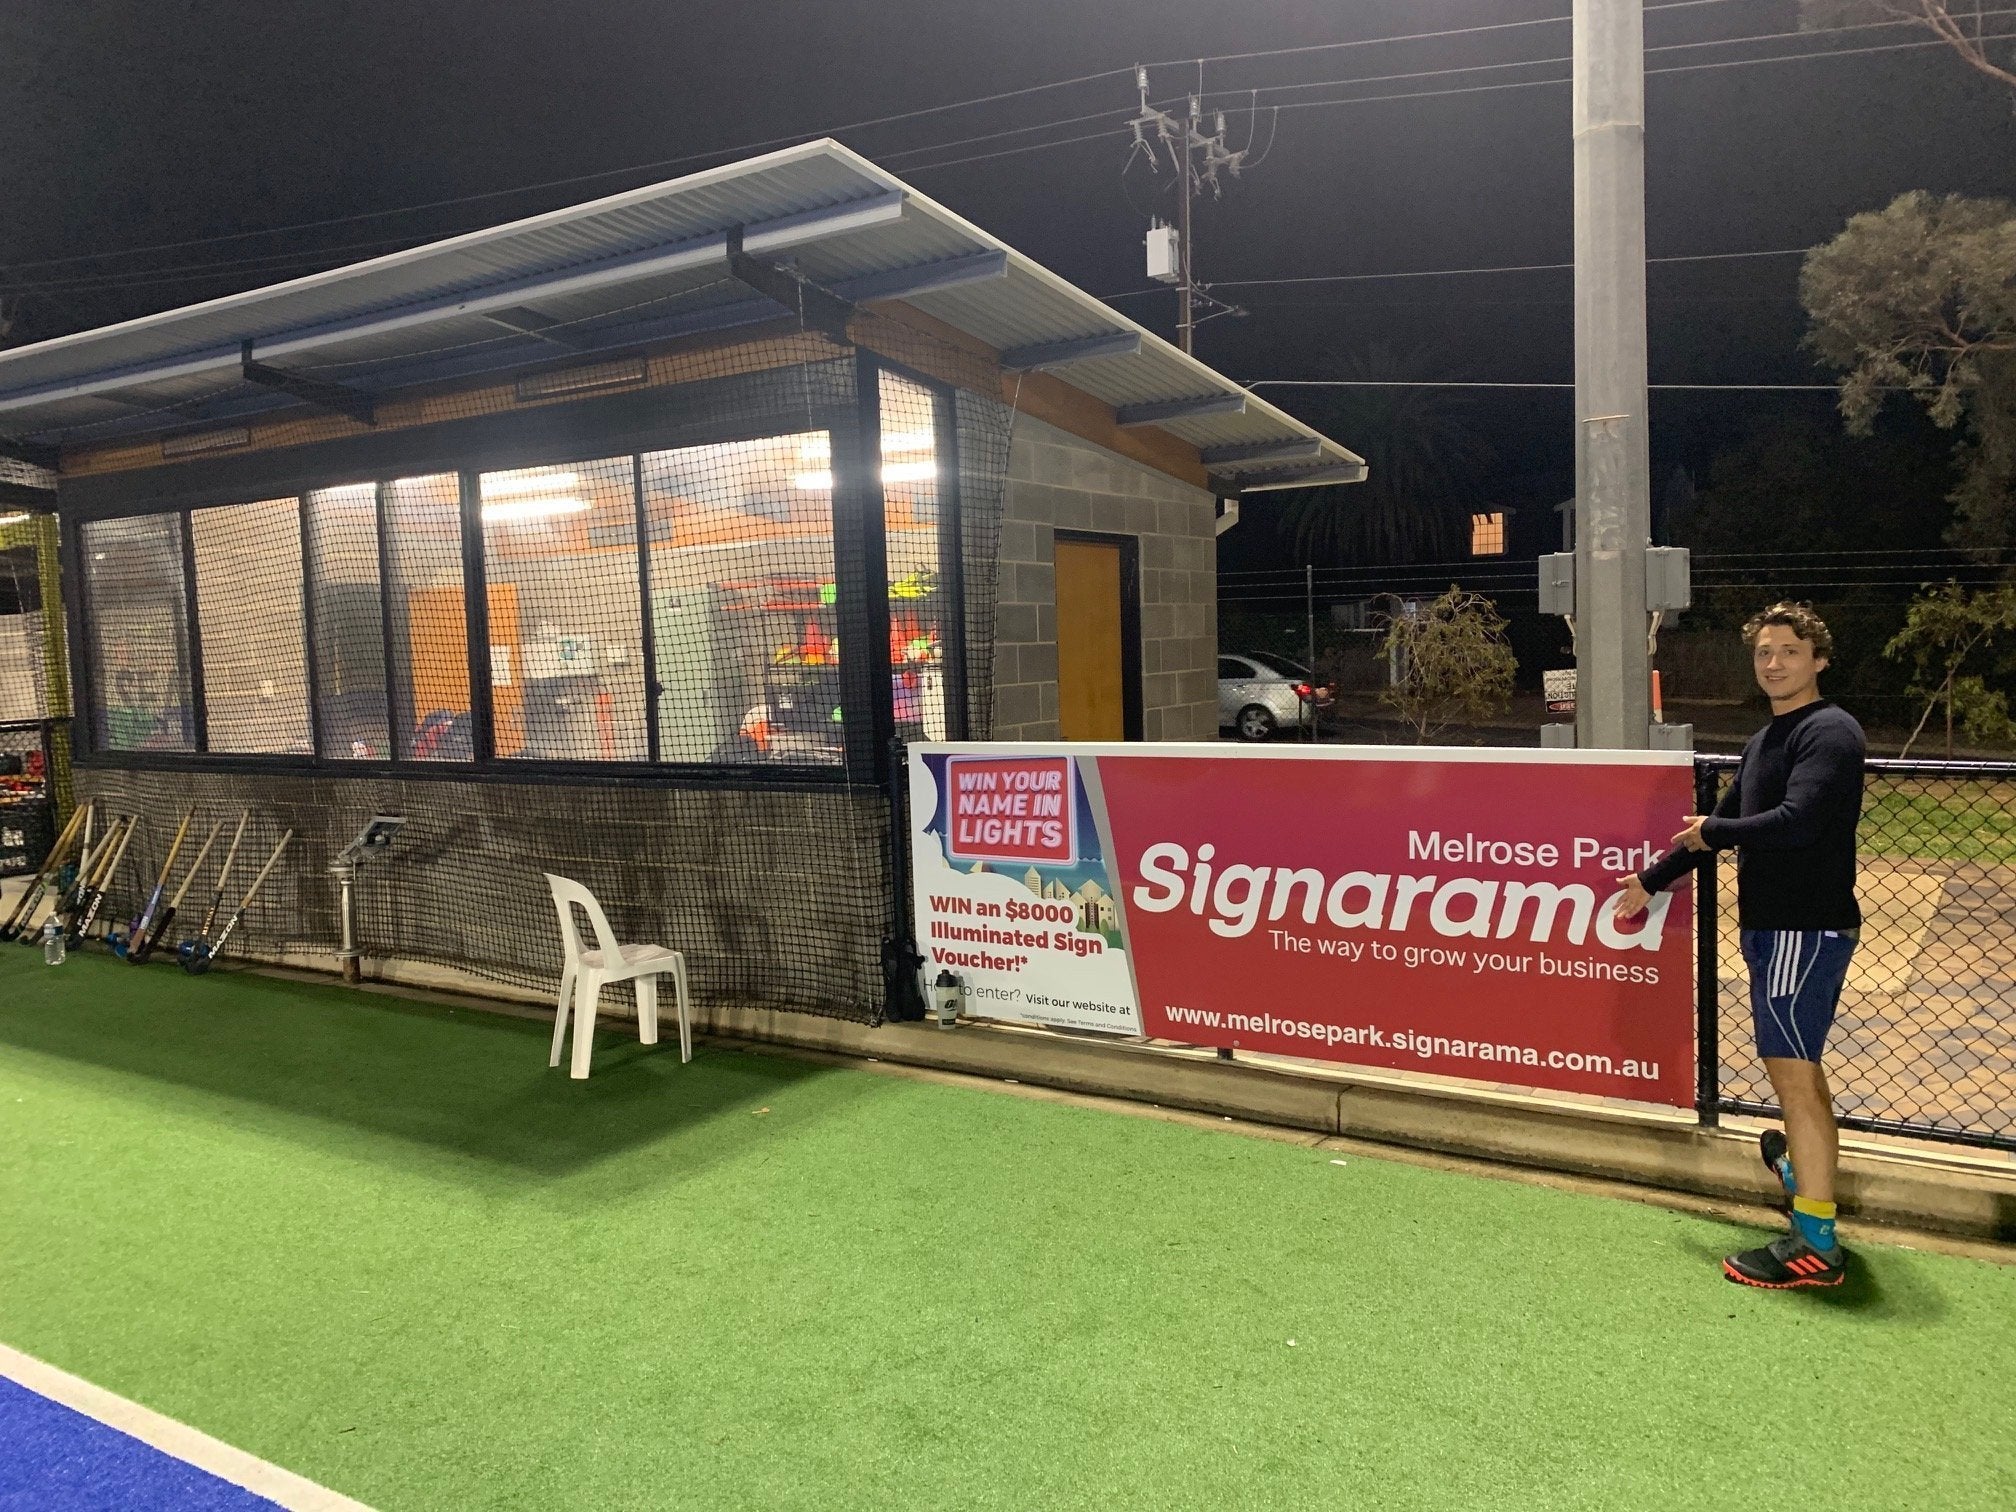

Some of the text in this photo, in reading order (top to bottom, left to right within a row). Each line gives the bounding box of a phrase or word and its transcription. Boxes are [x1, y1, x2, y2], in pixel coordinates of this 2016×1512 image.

[958, 770, 1062, 792] WIN YOUR
[958, 793, 1062, 817] NAME IN
[959, 818, 1063, 848] LIGHTS
[1408, 830, 1666, 871] Melrose Park
[929, 895, 1074, 924] WIN an $8000
[1133, 842, 1673, 951] Signarama
[78, 893, 103, 937] MAZON
[208, 915, 239, 959] MAZON
[930, 921, 1103, 957] Illuminated Sign
[1268, 929, 1660, 985] The way to grow your business
[976, 987, 1021, 1002] enter?
[1026, 993, 1131, 1016] Visit our website at
[1107, 1022, 1138, 1033] Conditions
[1165, 1005, 1660, 1080] www.melrosepark.signarama.com.au
